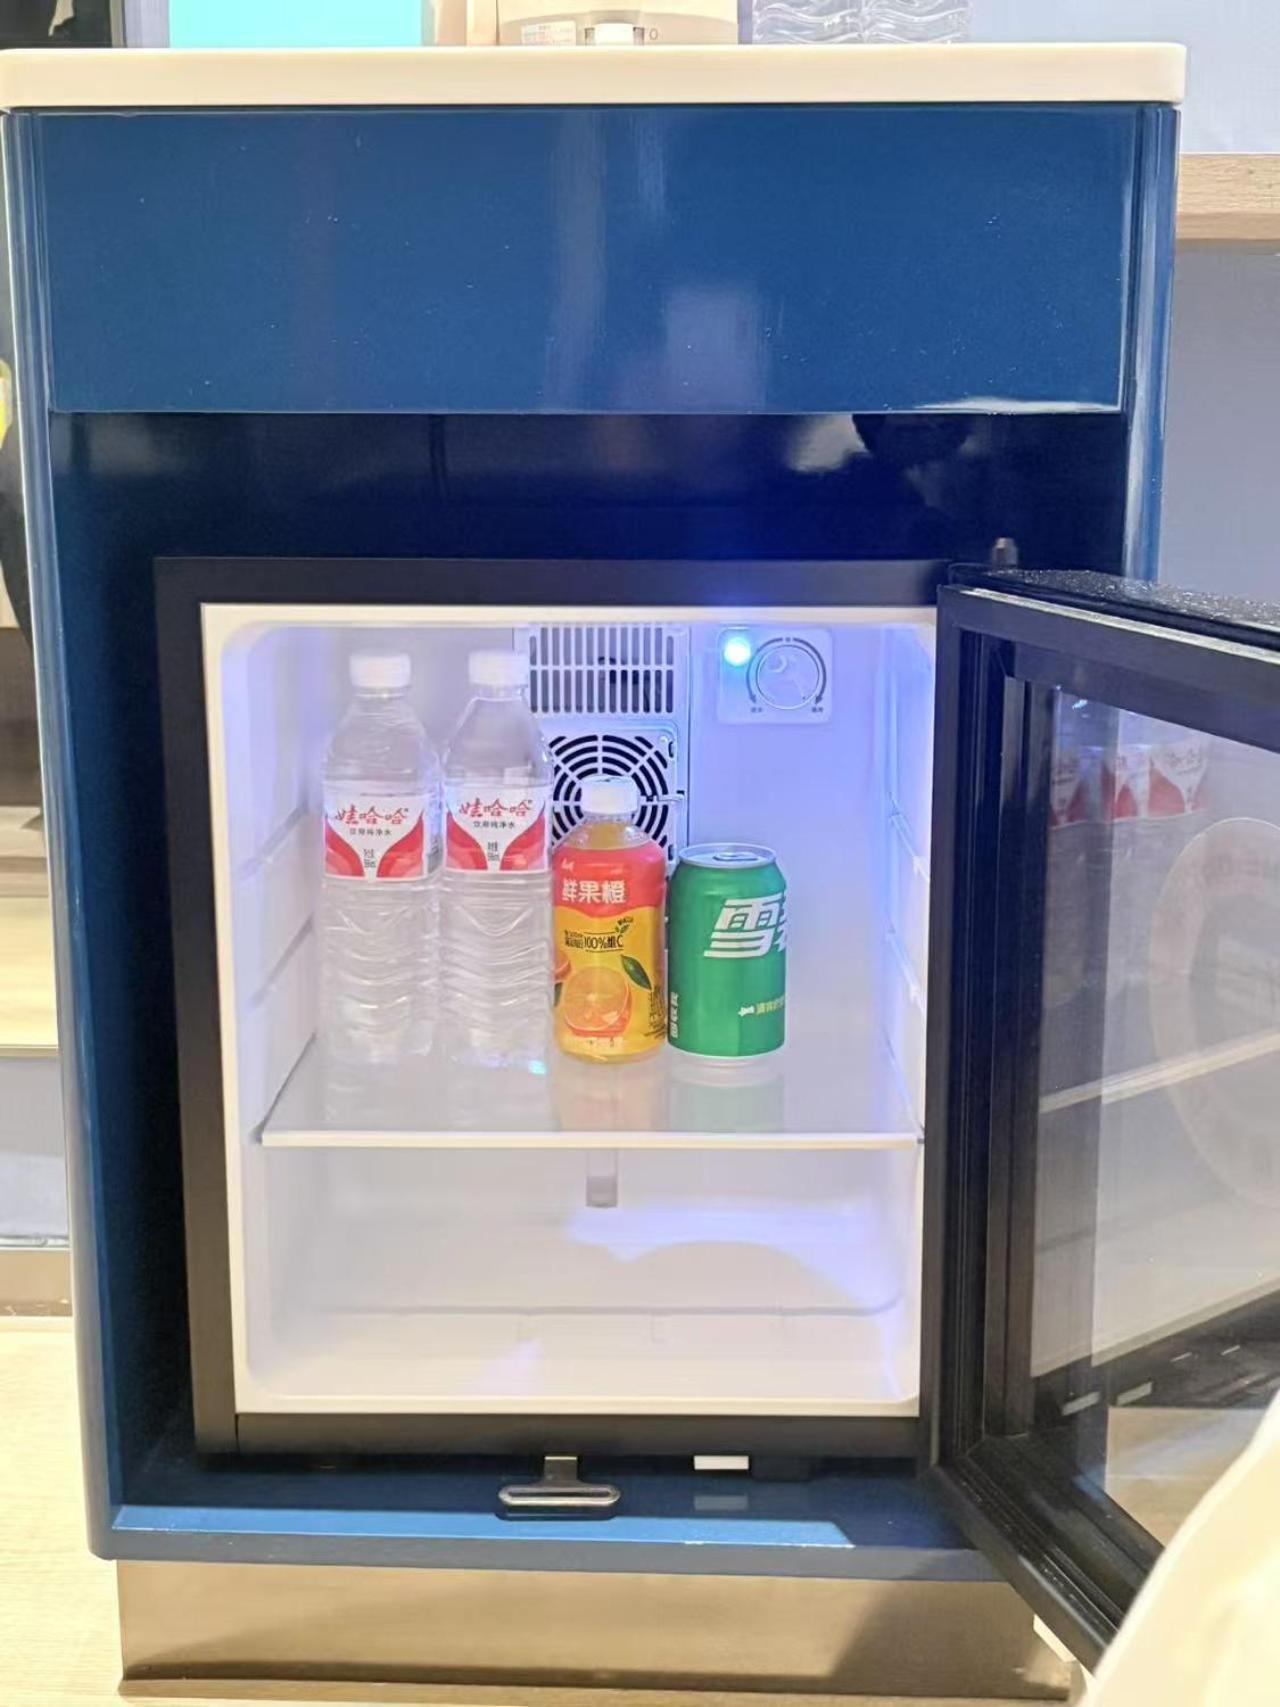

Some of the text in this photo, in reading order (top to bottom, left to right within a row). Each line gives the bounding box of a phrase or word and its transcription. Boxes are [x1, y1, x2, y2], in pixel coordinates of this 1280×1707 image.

[335, 803, 408, 825] 娃哈哈
[459, 798, 532, 818] 娃哈哈
[562, 879, 626, 904] 鲜果橙
[703, 893, 786, 957] 雪
